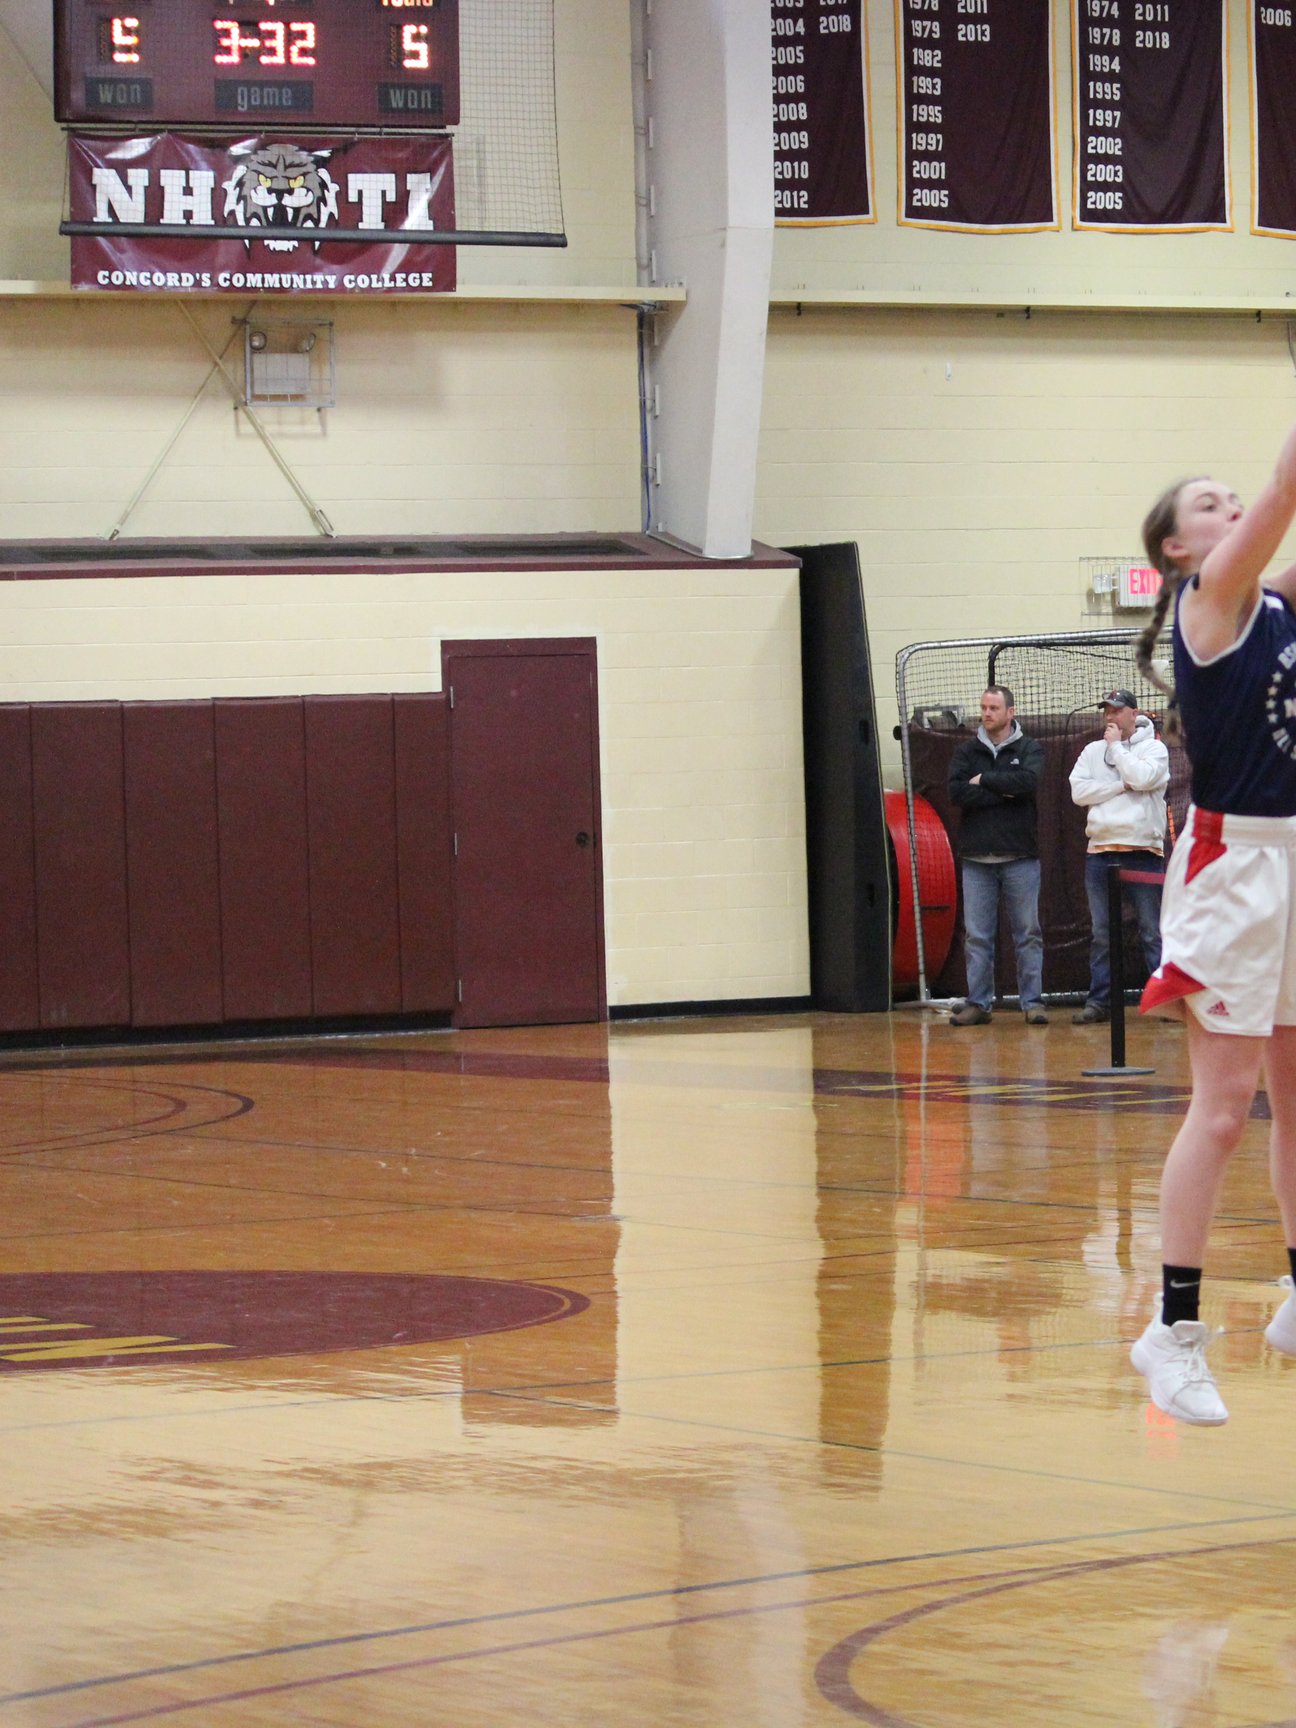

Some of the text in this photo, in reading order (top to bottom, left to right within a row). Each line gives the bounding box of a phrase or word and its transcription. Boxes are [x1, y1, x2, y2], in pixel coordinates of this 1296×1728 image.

[1087, 0, 1119, 19] 1974
[1135, 4, 1169, 22] 2011
[1260, 7, 1292, 27] 2006
[819, 15, 851, 33] 2018
[911, 19, 940, 39] 1979
[957, 24, 991, 42] 2013
[1088, 27, 1121, 46] 1978
[1135, 31, 1170, 48] 2018
[402, 24, 429, 69] 5
[771, 46, 804, 64] 2005
[912, 48, 942, 67] 1982
[1088, 54, 1121, 73] 1994
[99, 82, 142, 104] won
[771, 75, 805, 93] 2006
[911, 76, 941, 95] 1993
[1088, 81, 1121, 100] 1995
[237, 86, 293, 112] game
[389, 88, 432, 109] won
[772, 102, 807, 121] 2008
[911, 104, 942, 123] 1995
[1088, 109, 1121, 128] 1997
[772, 131, 809, 150] 2009
[911, 132, 943, 151] 1997
[1087, 137, 1122, 155] 2002
[774, 161, 809, 179] 2010
[912, 160, 946, 179] 2001
[1087, 164, 1123, 182] 2003
[774, 190, 809, 208] 2012
[912, 189, 949, 208] 2005
[1087, 192, 1123, 210] 2005
[97, 270, 434, 289] CONCORD'S COMMUNITY COLLEGE
